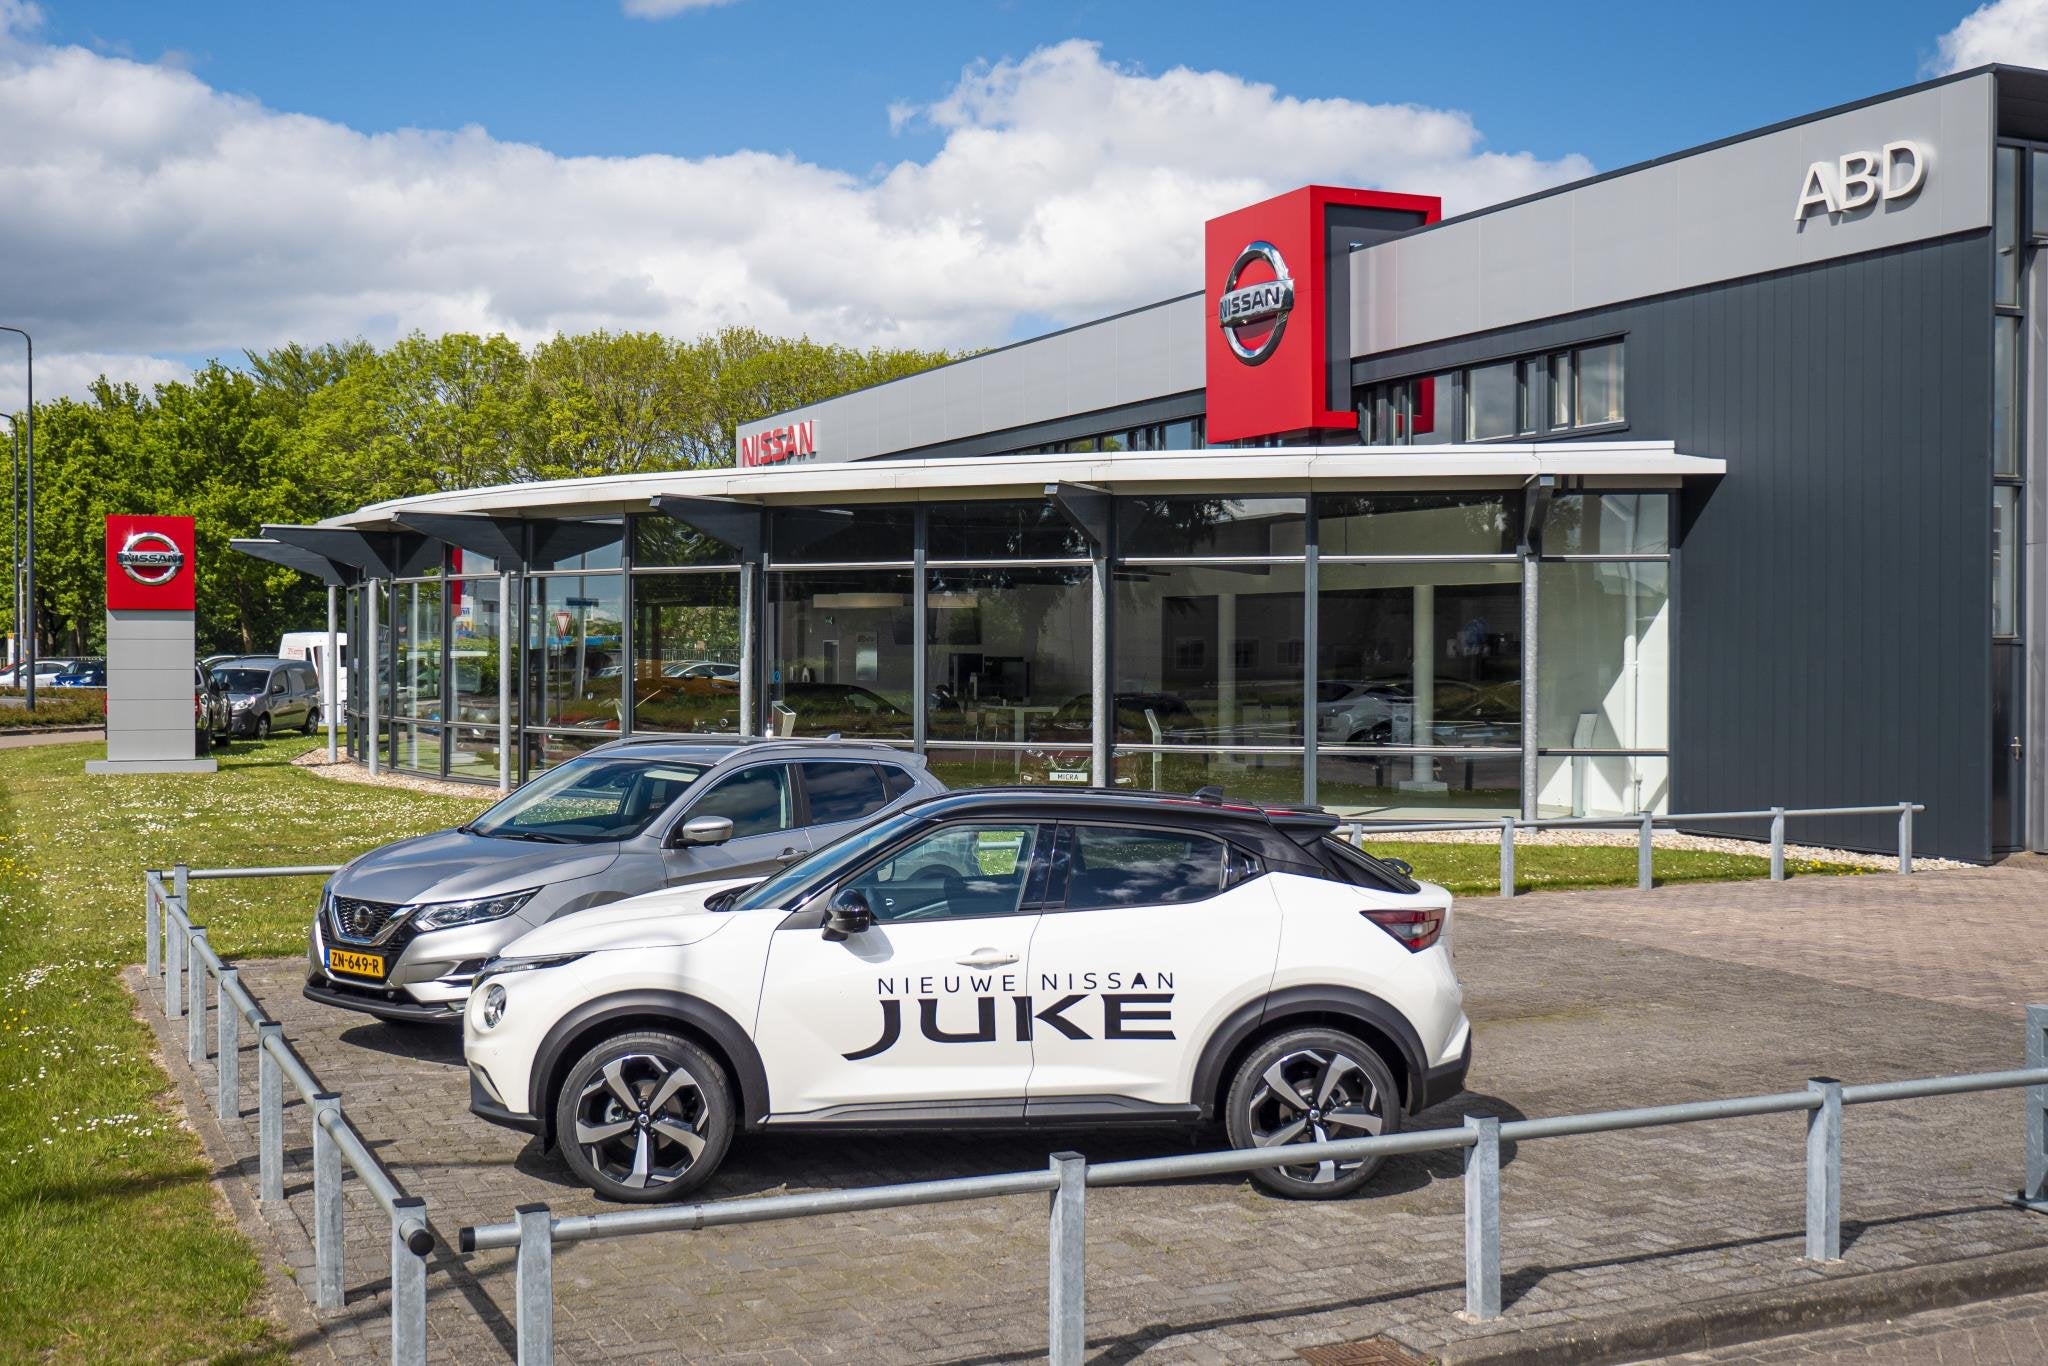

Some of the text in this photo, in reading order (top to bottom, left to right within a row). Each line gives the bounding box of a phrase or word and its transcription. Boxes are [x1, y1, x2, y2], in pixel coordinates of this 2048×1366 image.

[1794, 140, 1924, 221] ABD
[1220, 286, 1280, 319] NISSAN
[742, 419, 813, 467] NISSAN
[124, 553, 179, 564] NISSAN
[1057, 773, 1079, 781] MICRA
[331, 951, 379, 974] ZN-649-R
[878, 972, 1174, 995] NIEUWE NISSAN
[840, 994, 1177, 1061] JUKE
